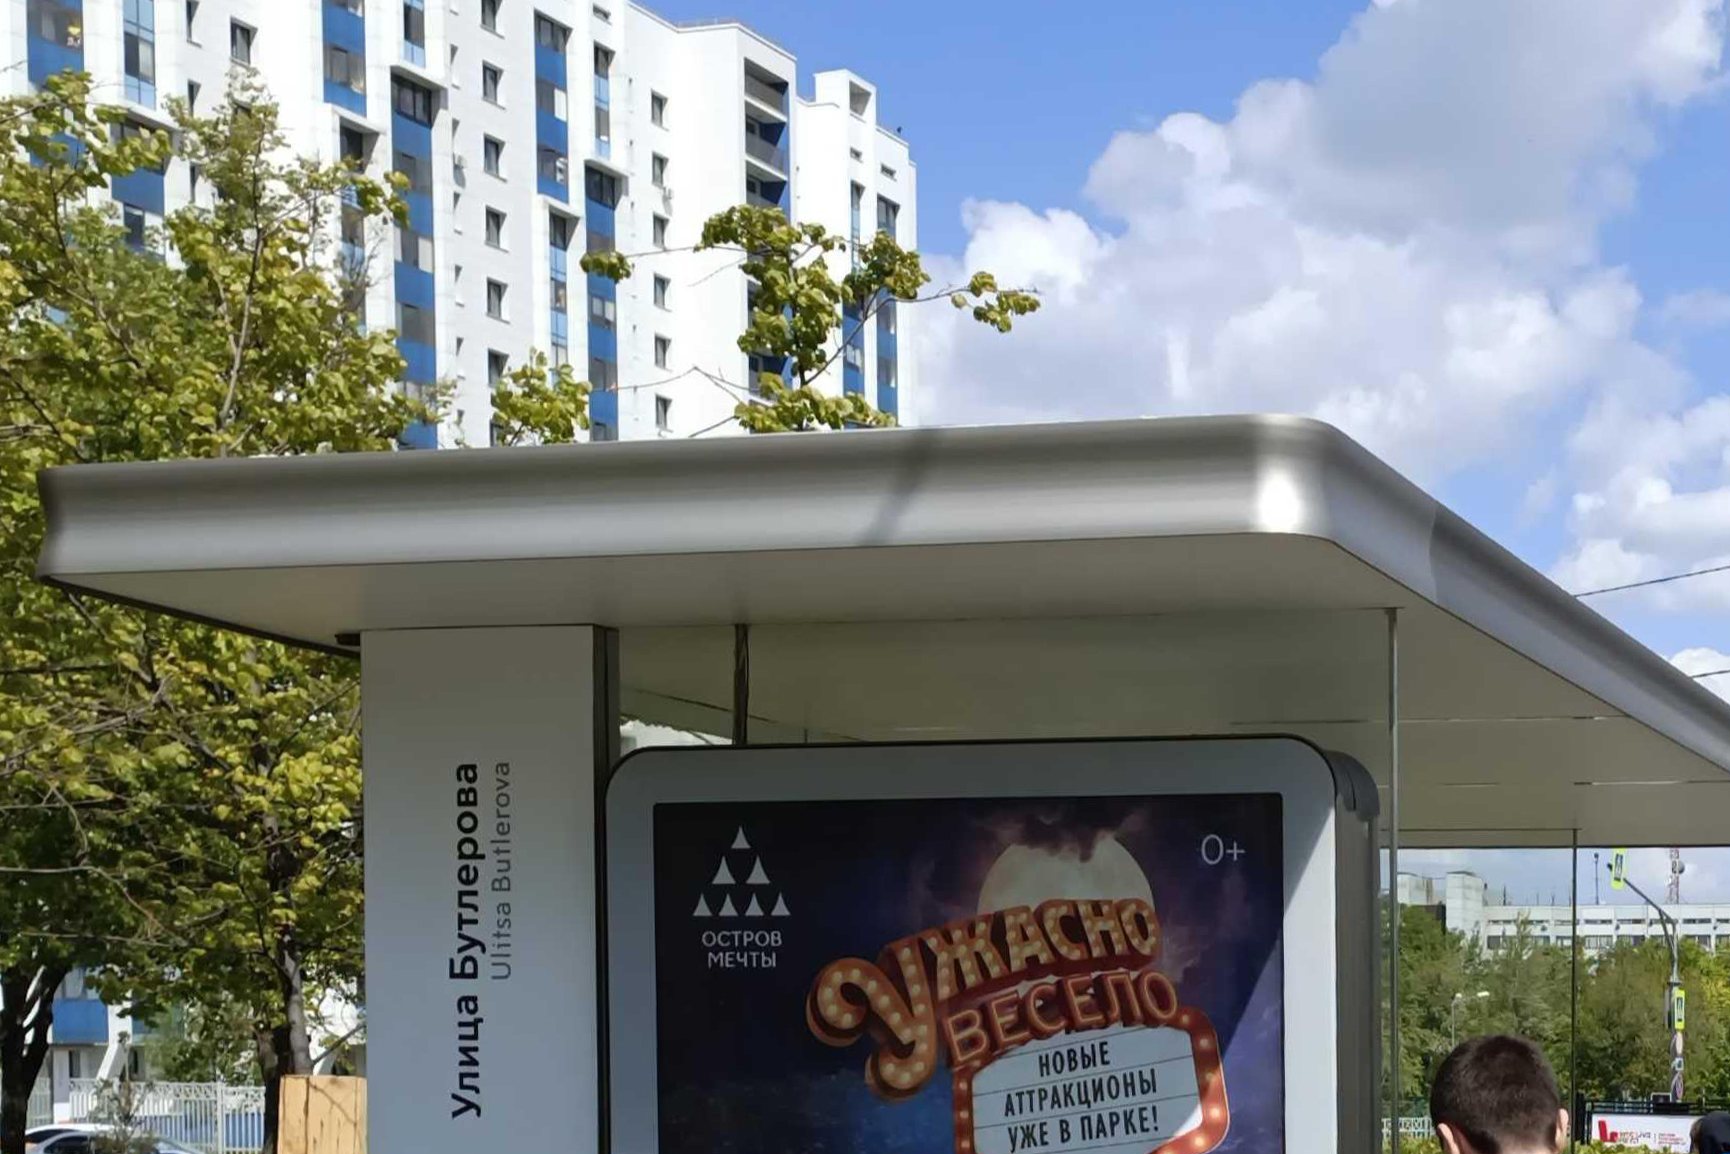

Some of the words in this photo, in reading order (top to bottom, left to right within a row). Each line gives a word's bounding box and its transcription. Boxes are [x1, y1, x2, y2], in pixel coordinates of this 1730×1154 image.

[490, 761, 512, 892] Butlerova
[1201, 833, 1246, 865] 0+
[449, 762, 486, 980] Бутлерова
[490, 902, 512, 980] Ulitsa
[701, 930, 783, 948] ОСТРОВ
[707, 950, 777, 969] МЕЧТЫ
[807, 899, 1160, 1098] УЖАСНО
[944, 968, 1179, 1066] ВЕСЕЛО
[451, 995, 484, 1119] Улица
[1038, 1041, 1111, 1078] НОВЫЕ
[1004, 1068, 1158, 1118] АТТРАКЦИОНЫ
[1008, 1121, 1049, 1154] УЖЕ
[1059, 1119, 1071, 1144] В
[1080, 1104, 1159, 1142] ПАРКЕ!
